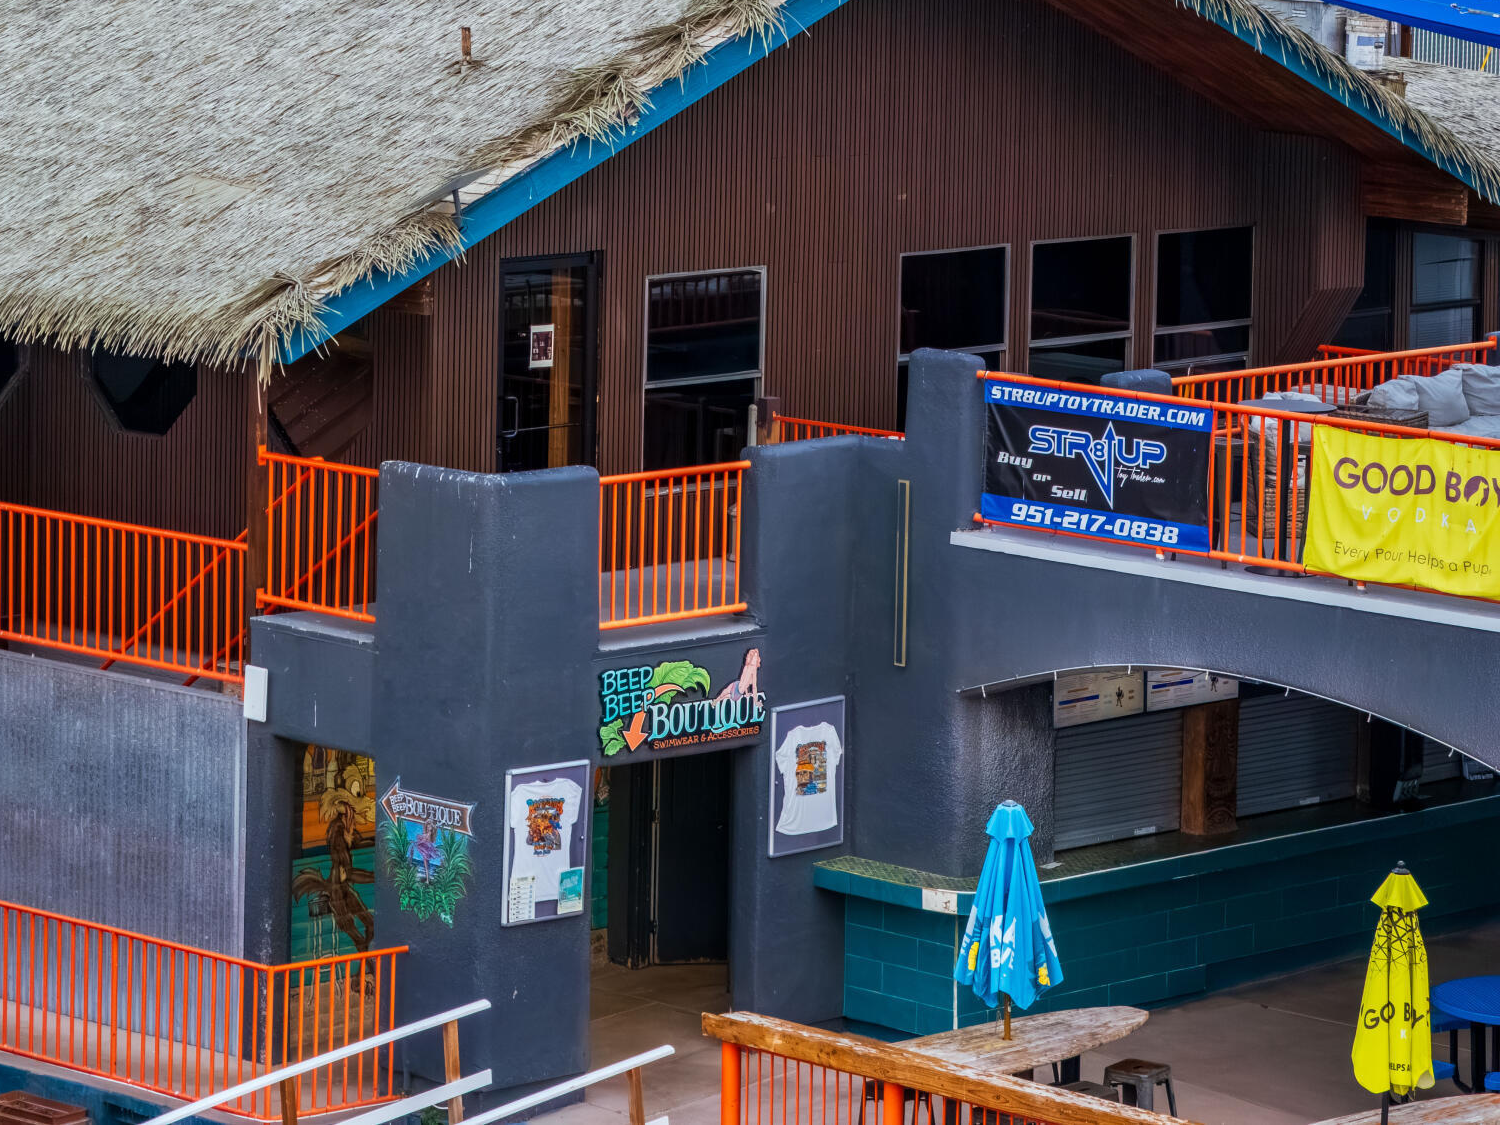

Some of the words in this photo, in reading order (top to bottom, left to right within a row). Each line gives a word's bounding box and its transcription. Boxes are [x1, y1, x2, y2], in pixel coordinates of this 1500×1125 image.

[991, 385, 1206, 427] STR8UPTOYTRADER.COM
[997, 451, 1033, 469] Buy
[1033, 473, 1052, 482] or
[1333, 457, 1436, 496] GOOD
[1051, 485, 1087, 501] Sell
[1011, 503, 1179, 544] 951-217-0838
[1362, 505, 1477, 534] VODKA
[1334, 541, 1370, 562] Every
[1375, 548, 1403, 562] Pour
[1408, 550, 1445, 570] Helps
[1449, 562, 1458, 572] a
[602, 666, 653, 695] BEEP
[603, 688, 656, 722] BEEP
[648, 692, 767, 742] BOUTIQUE
[653, 735, 699, 749] SWIMWEAR
[701, 734, 706, 742] &
[707, 726, 760, 741] ACCESSORIES
[389, 793, 404, 805] BEEP
[404, 794, 462, 828] BOUTIQUE
